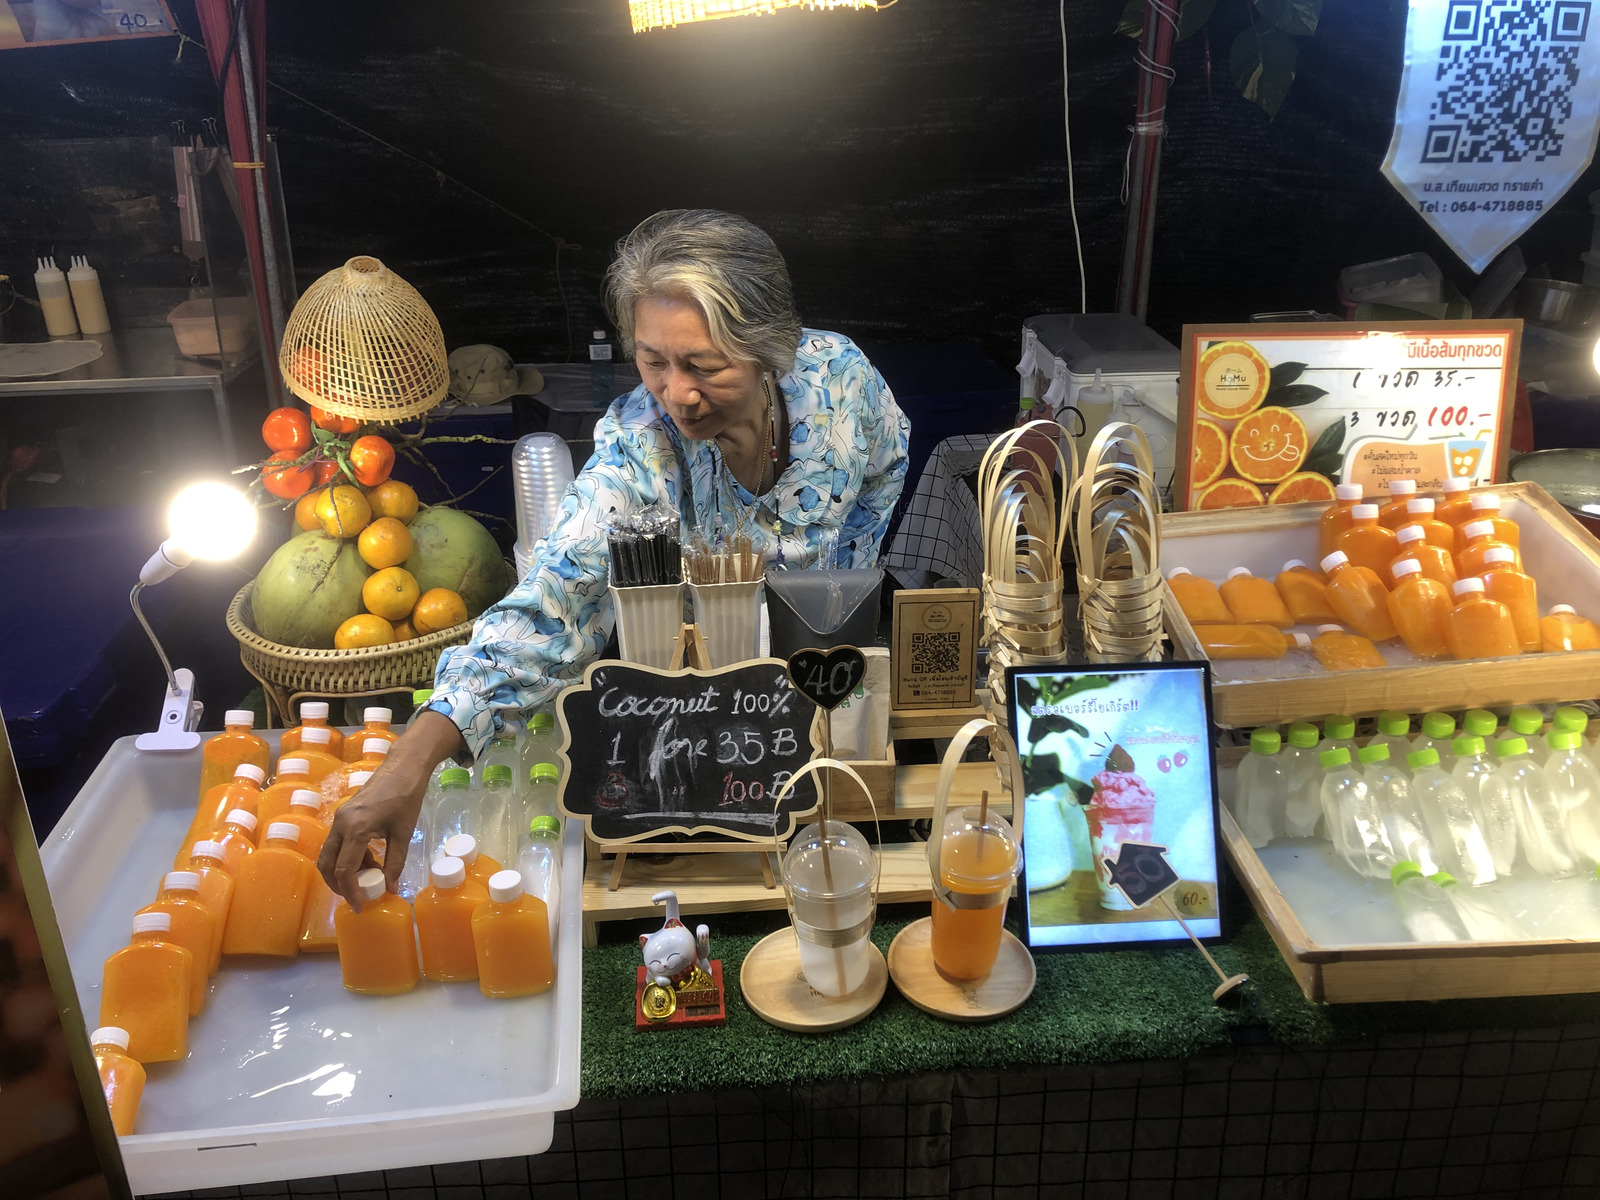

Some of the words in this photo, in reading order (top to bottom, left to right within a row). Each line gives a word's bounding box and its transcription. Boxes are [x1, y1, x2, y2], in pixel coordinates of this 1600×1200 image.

[120, 13, 148, 34] 40
[1419, 201, 1439, 213] Tel
[1450, 200, 1544, 213] 064-4718885
[1350, 410, 1360, 427] 3
[606, 731, 625, 766] 1
[715, 731, 765, 765] 35
[770, 727, 798, 756] B
[718, 771, 764, 807] 100
